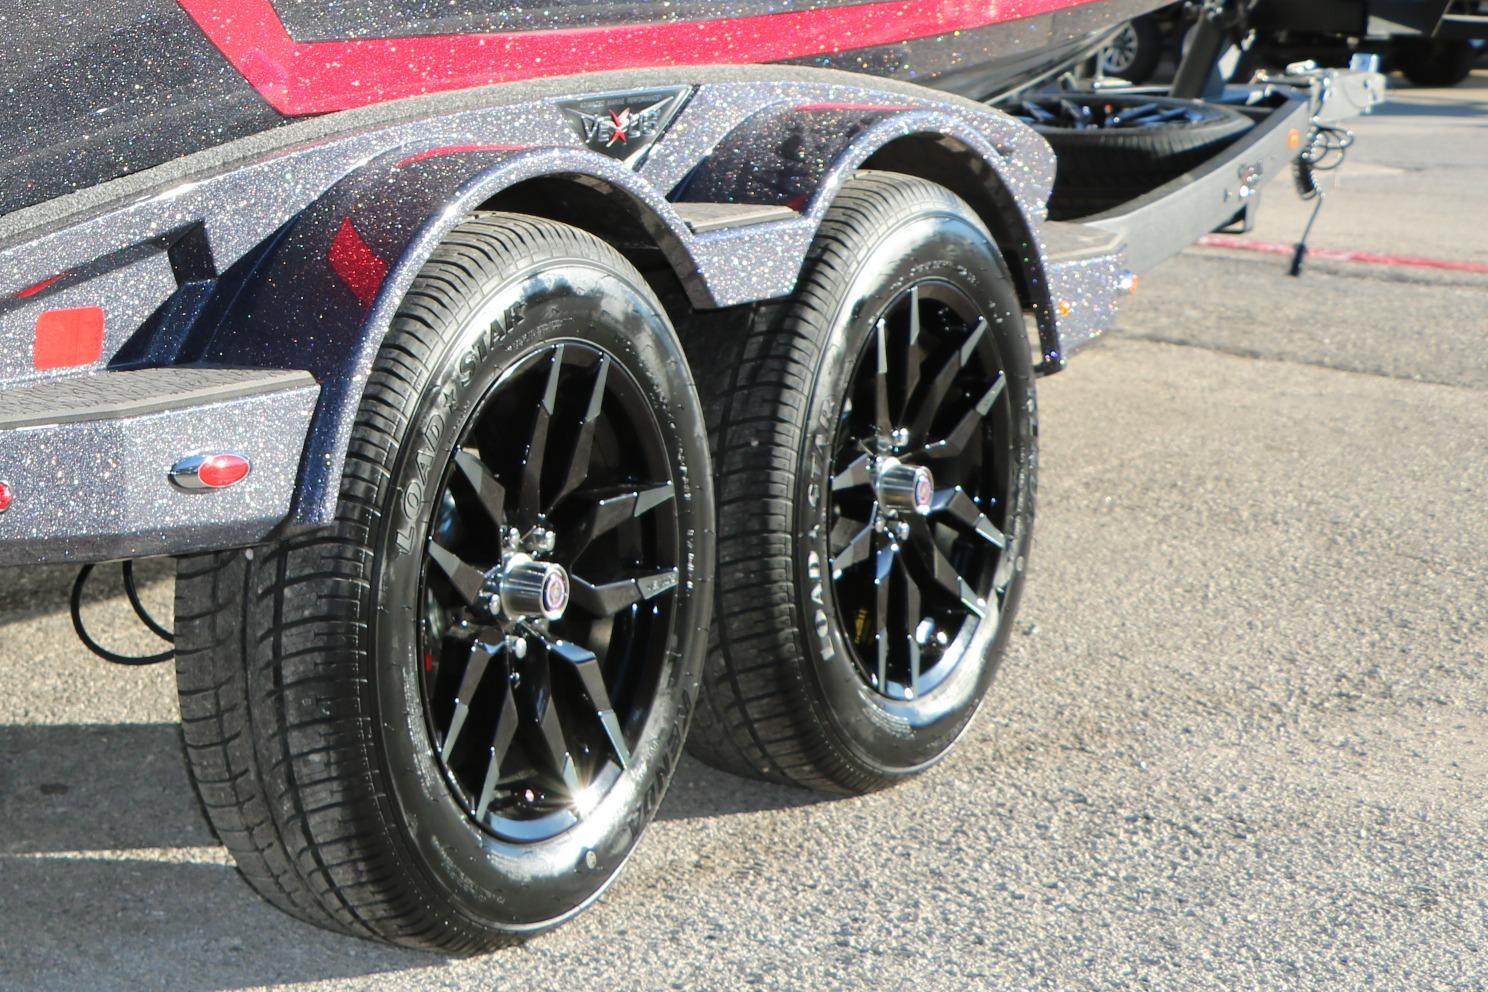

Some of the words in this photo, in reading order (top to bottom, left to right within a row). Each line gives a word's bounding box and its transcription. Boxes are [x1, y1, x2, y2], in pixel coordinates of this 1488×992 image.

[396, 412, 445, 555] LOAD
[458, 300, 529, 386] STAR
[807, 549, 835, 661] LOAD
